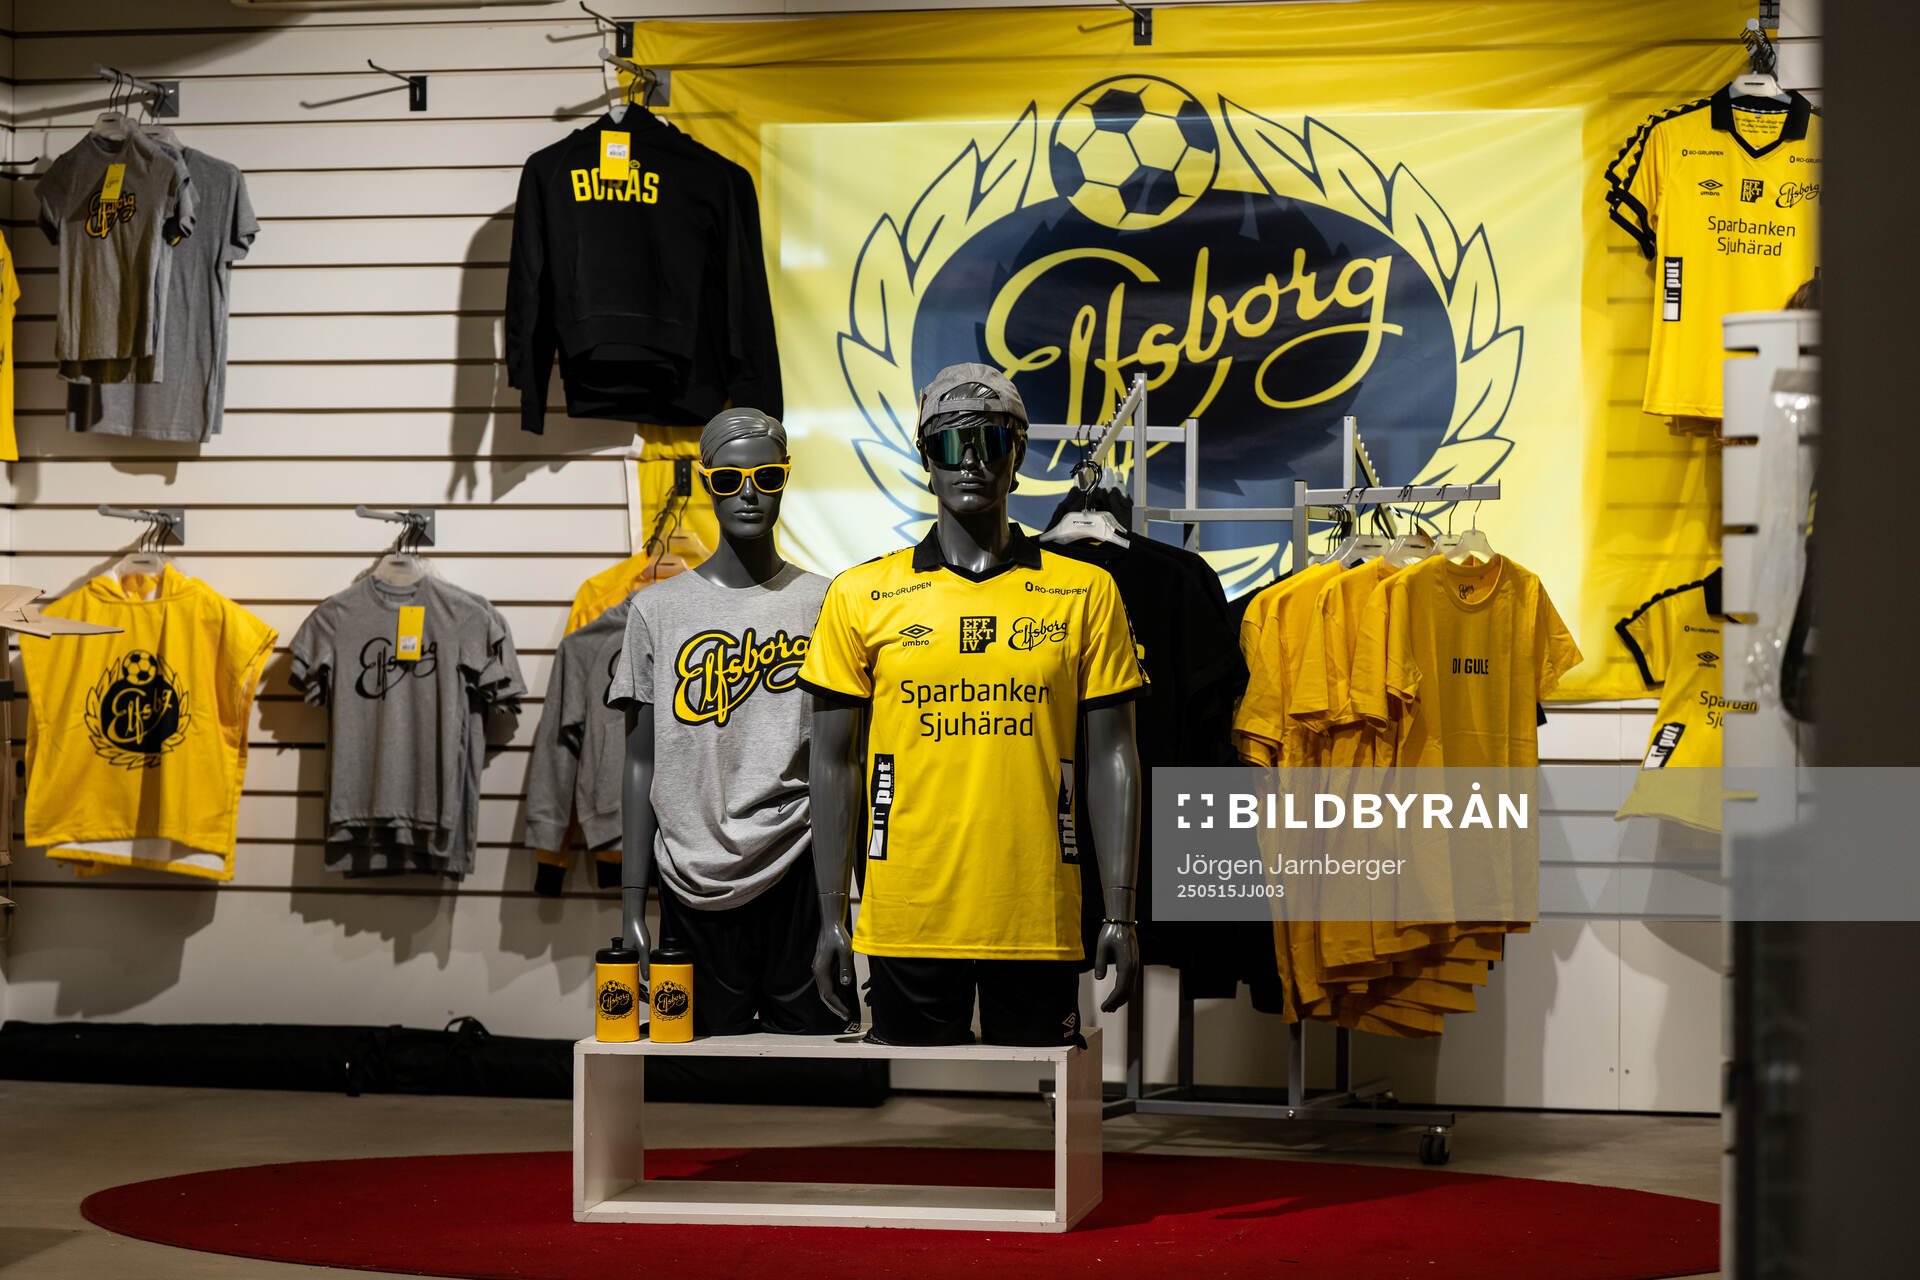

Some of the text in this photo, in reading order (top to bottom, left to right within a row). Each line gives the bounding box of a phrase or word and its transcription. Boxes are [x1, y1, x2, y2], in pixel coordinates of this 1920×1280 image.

[1708, 215, 1796, 238] Sparbanken
[1717, 237, 1782, 257] Sjuhärad
[881, 581, 932, 599] RO-GRUPPEN
[1034, 585, 1088, 596] RO-GRUPPEN
[902, 640, 930, 648] umbro
[1008, 616, 1069, 652] Elfsborg
[1452, 658, 1489, 675] DI GULE
[900, 677, 1050, 709] Sparbanken
[919, 711, 1033, 742] Sjuhärad
